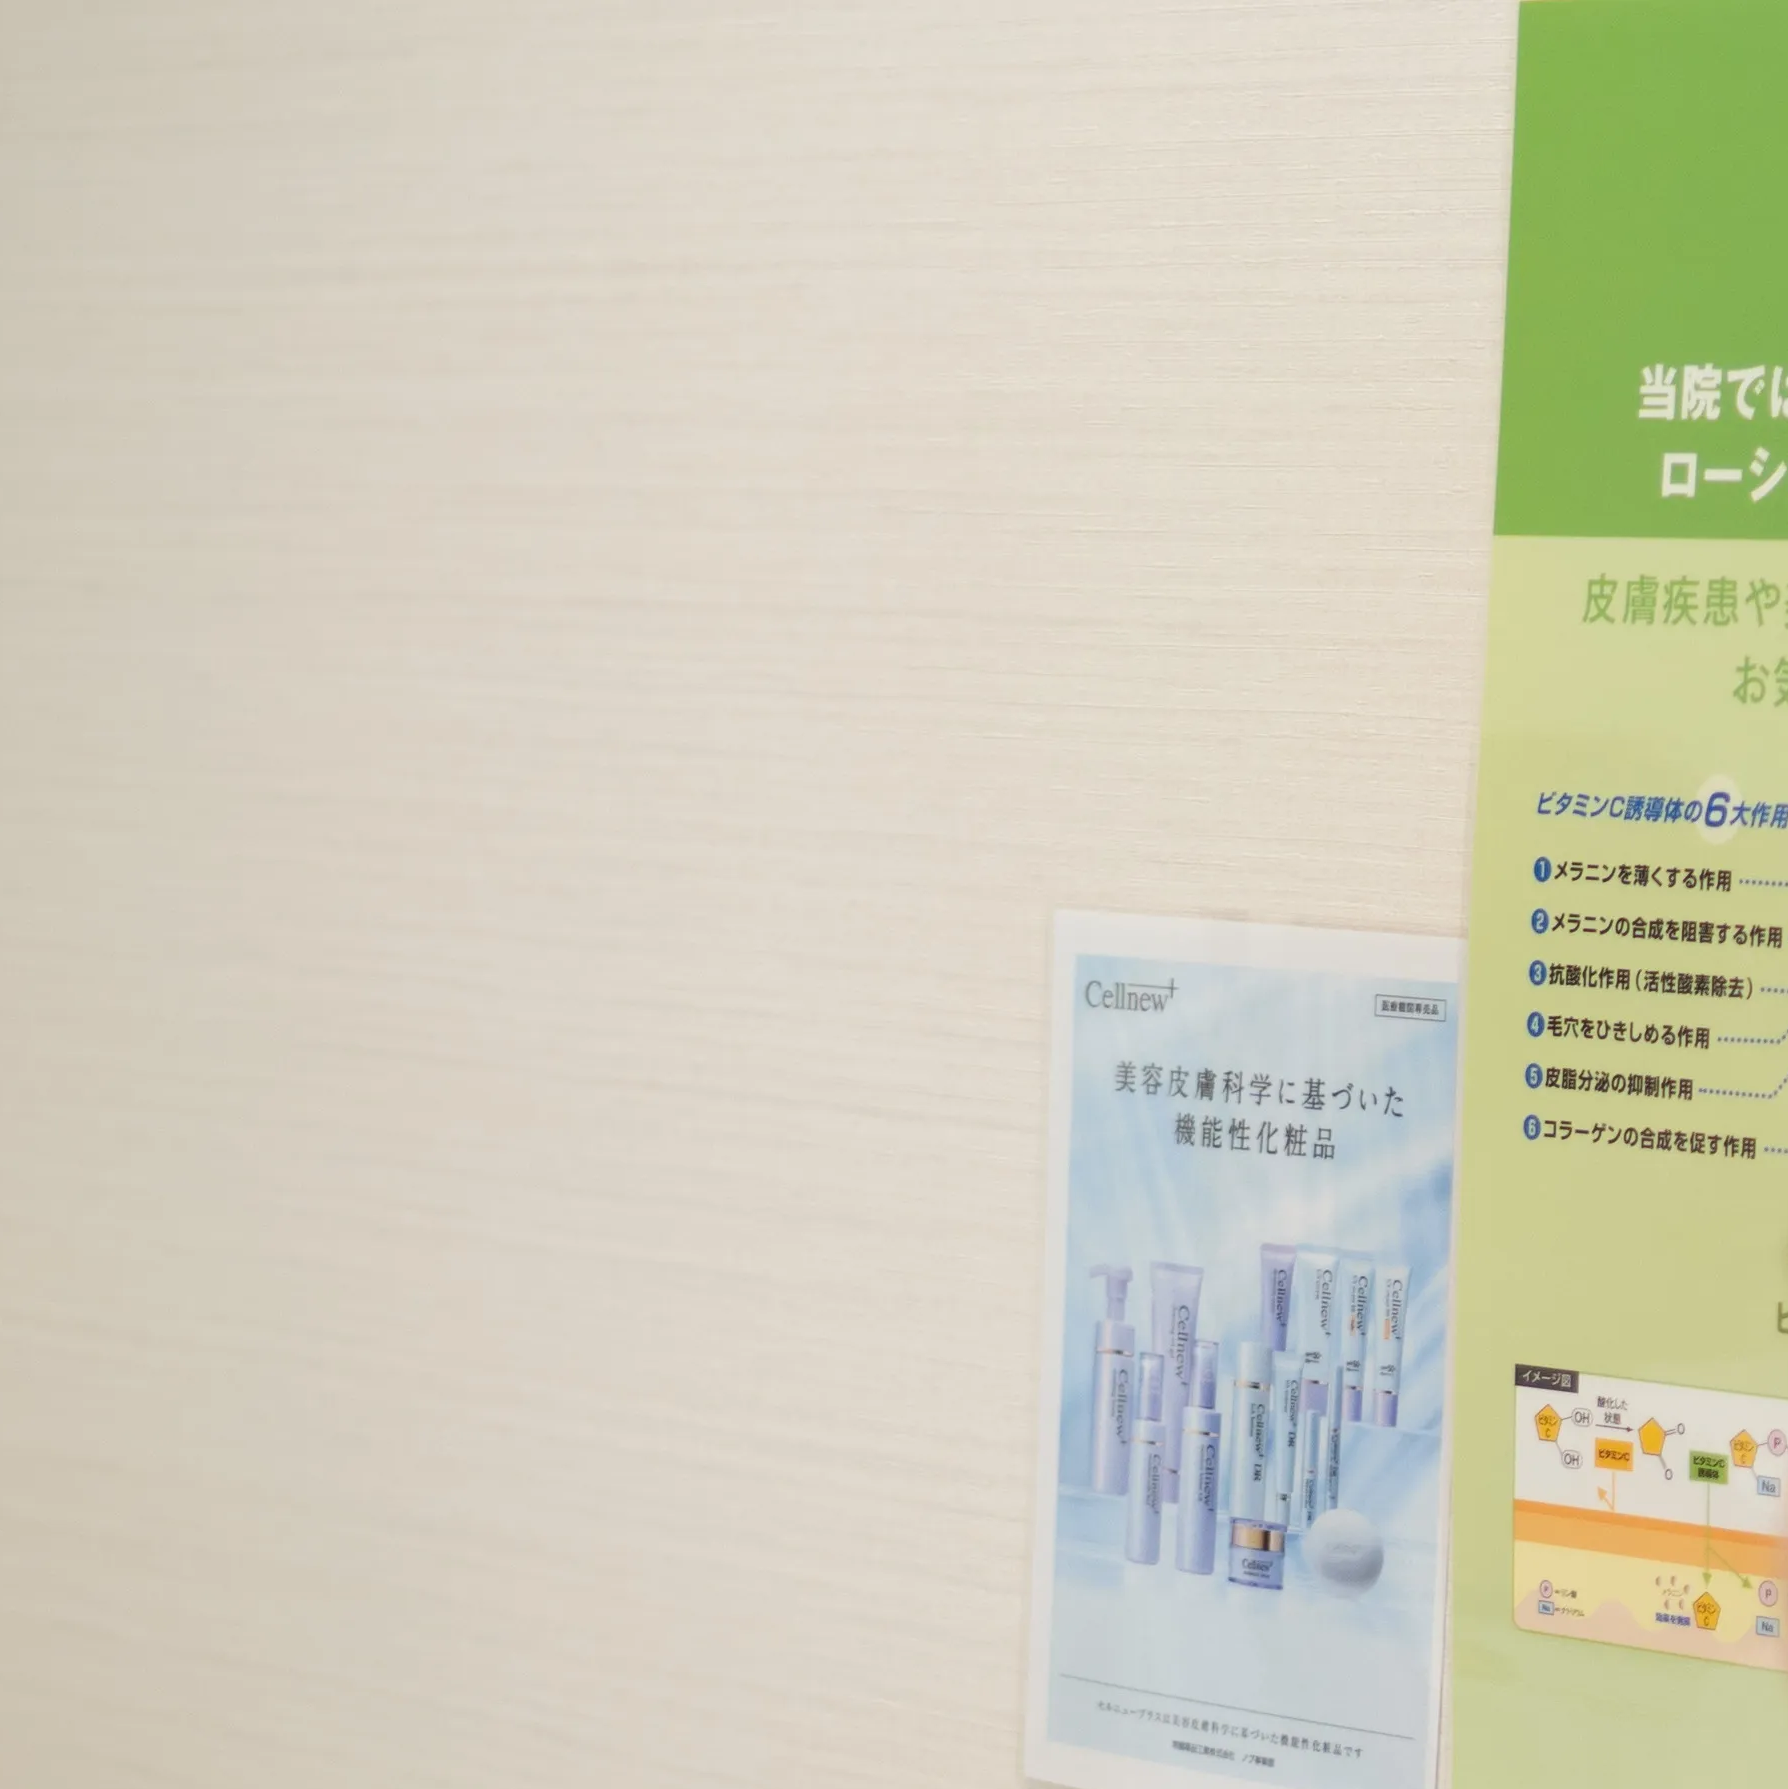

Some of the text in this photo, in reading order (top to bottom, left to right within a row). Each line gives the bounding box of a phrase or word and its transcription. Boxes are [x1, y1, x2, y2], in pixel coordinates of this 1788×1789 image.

[1554, 859, 1733, 893] メラニンを薄くする作用
[1552, 913, 1783, 948] メラニンの合成を阻害する作用
[1546, 1014, 1710, 1050] 毛穴をひきしめる作用
[1114, 1060, 1404, 1118] 美容皮膚科学に基づいた
[1545, 1066, 1694, 1100] 皮脂分泌の抑制作用
[1174, 1112, 1336, 1160] 機能性化粧品
[1542, 1118, 1757, 1160] コラーゲンの合成を促す作用
[1522, 1371, 1571, 1387] イメージ図
[1575, 1412, 1590, 1423] OH
[1565, 1454, 1579, 1465] OH
[1762, 1481, 1776, 1492] Na
[1765, 1589, 1772, 1598] P
[1762, 1622, 1773, 1632] Na
